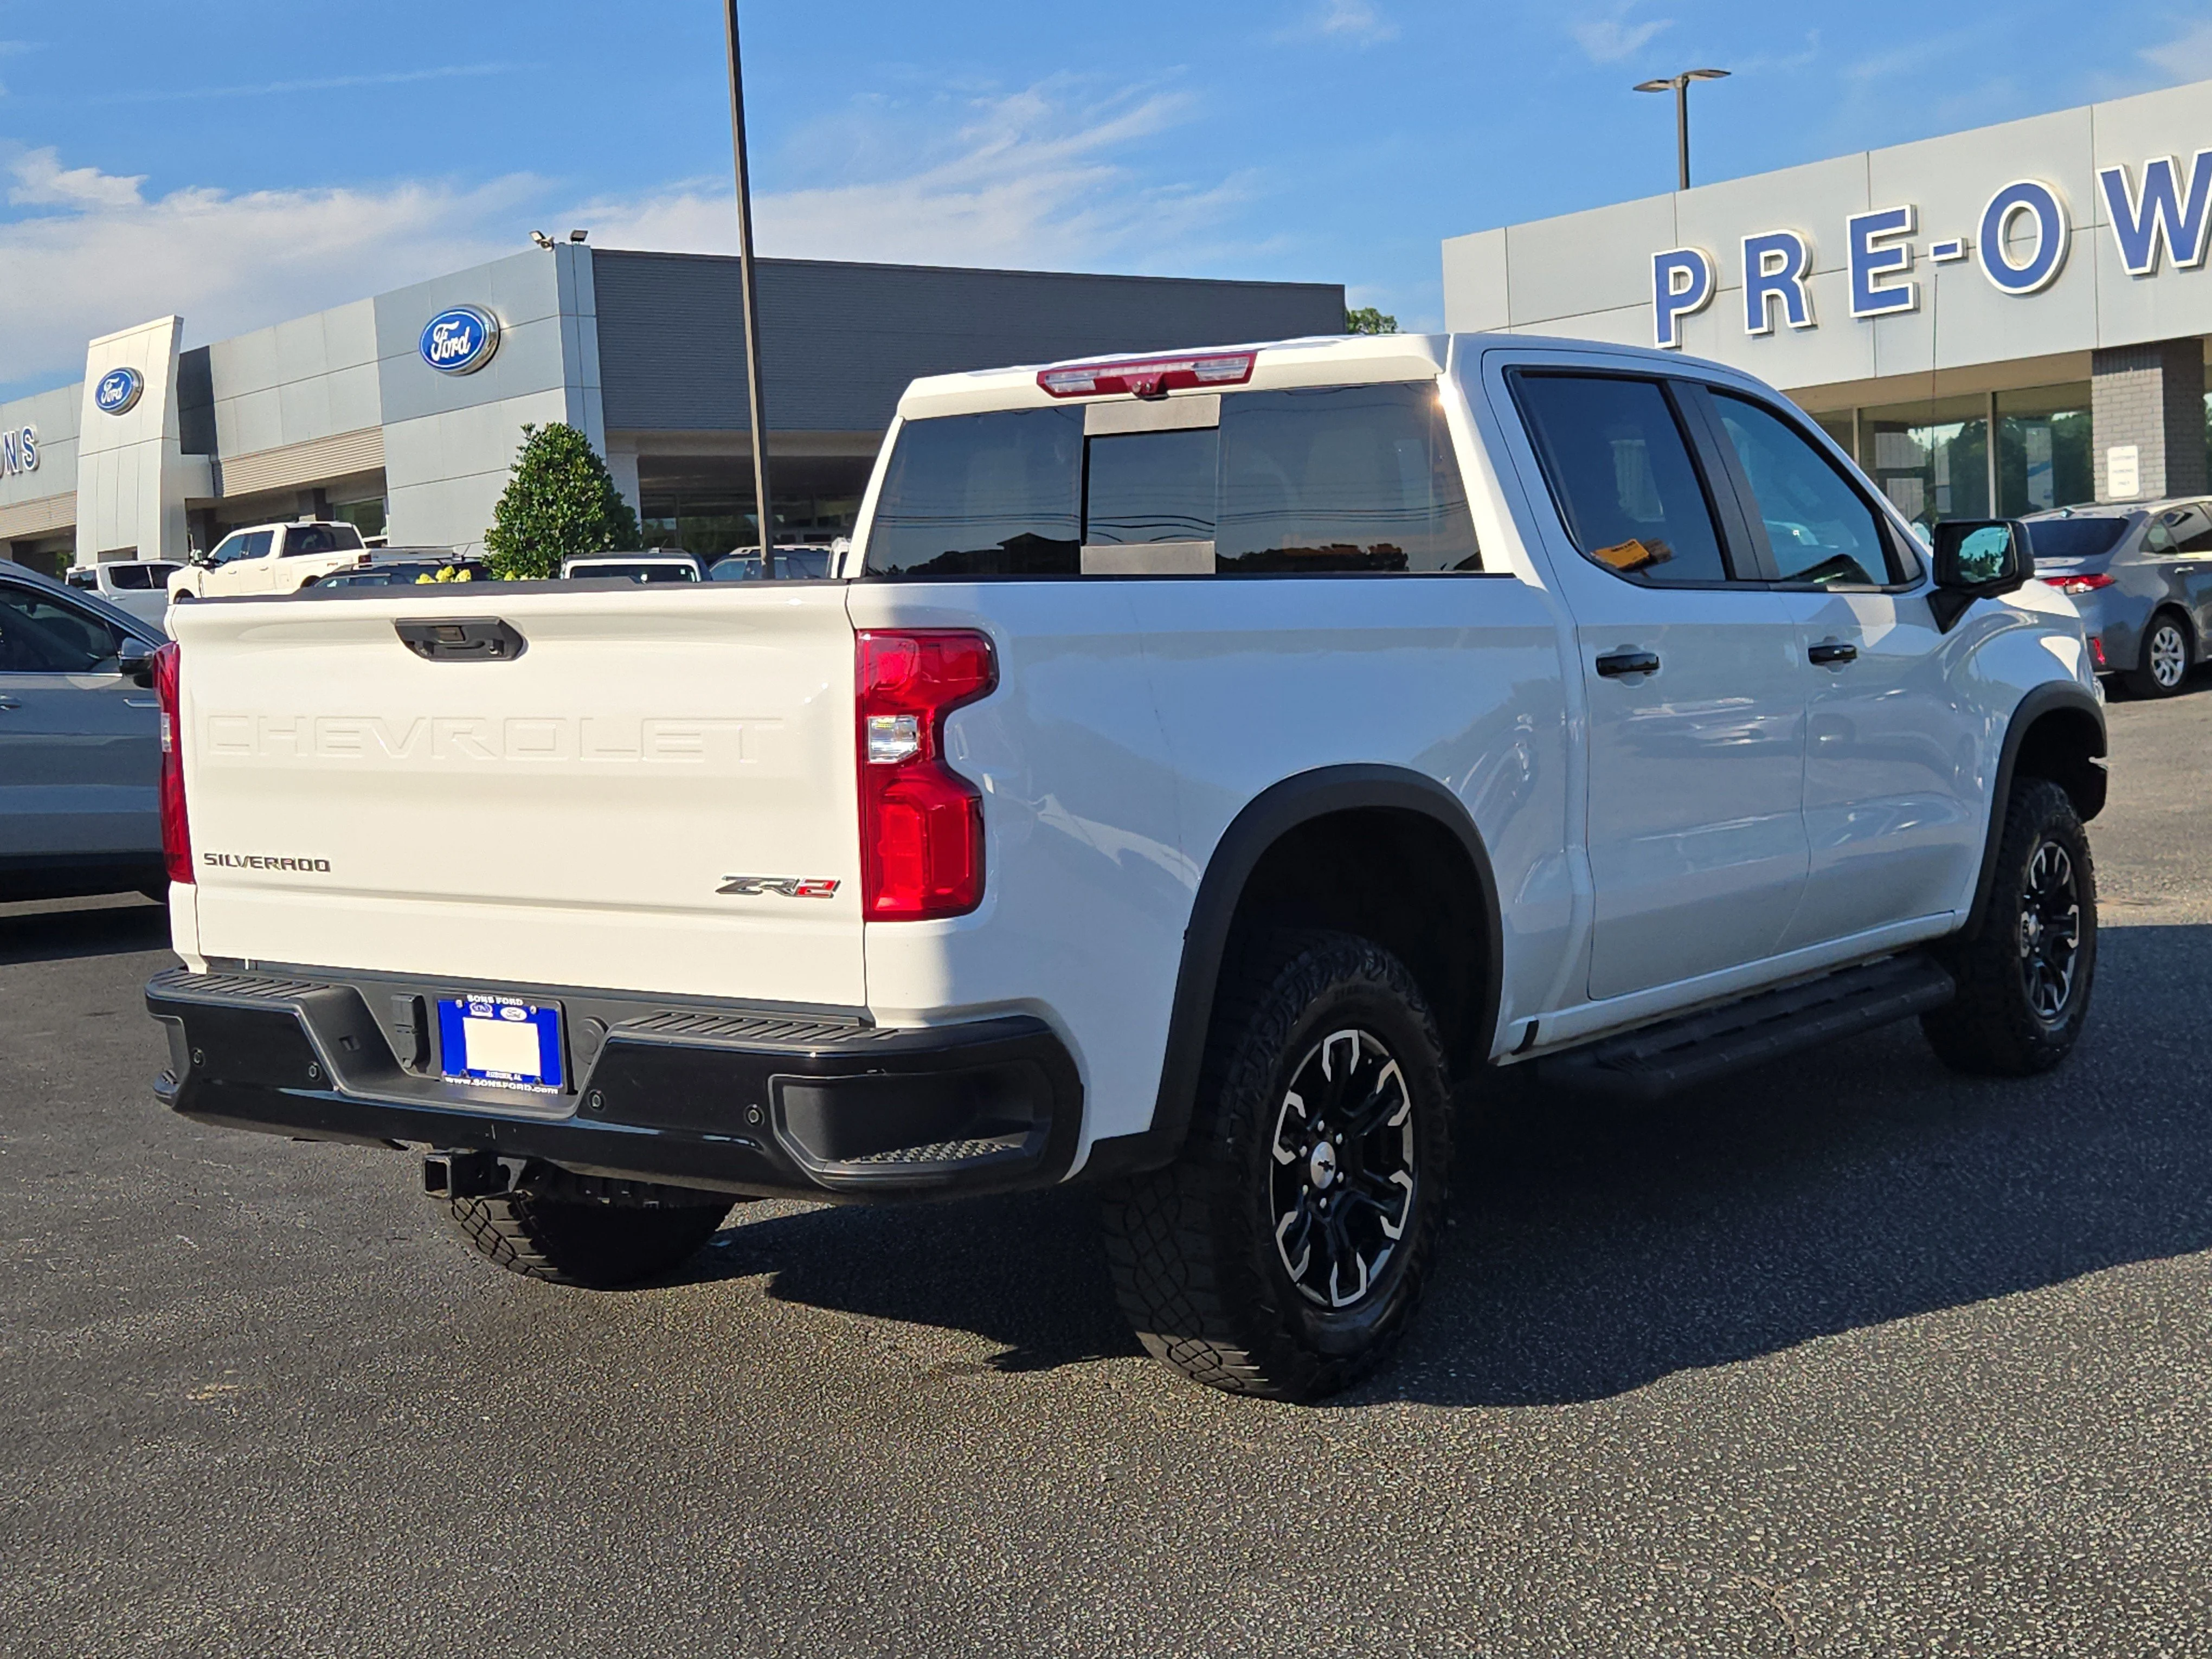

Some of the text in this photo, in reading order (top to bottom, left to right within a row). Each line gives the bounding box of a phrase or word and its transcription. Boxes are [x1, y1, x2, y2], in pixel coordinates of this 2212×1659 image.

[430, 320, 471, 361] Ford
[101, 377, 125, 403] Ford
[0, 426, 40, 478] NS
[208, 716, 783, 763] CHEVROLET
[204, 853, 331, 872] SILVERADO
[715, 874, 841, 899] ZR2
[467, 995, 524, 1006] SONS FORD
